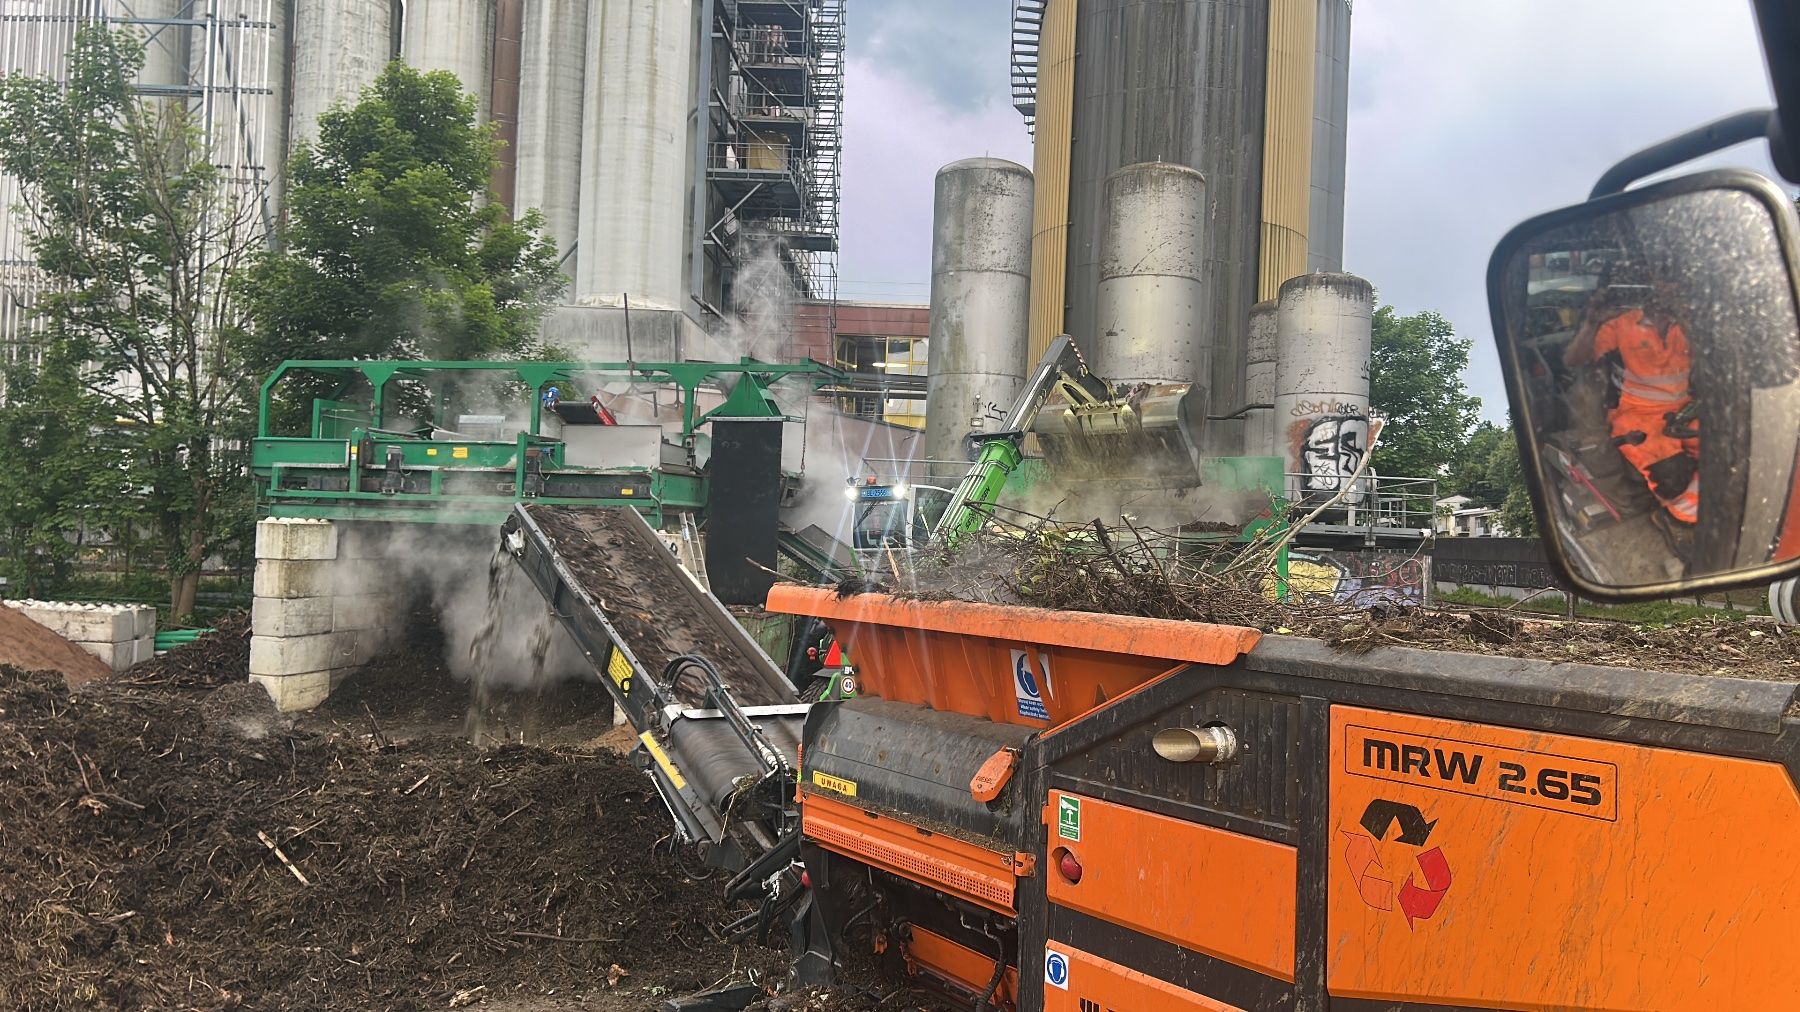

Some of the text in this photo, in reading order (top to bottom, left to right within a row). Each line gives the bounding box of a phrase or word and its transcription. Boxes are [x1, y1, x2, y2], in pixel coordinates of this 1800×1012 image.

[821, 777, 847, 792] UWAGA
[1363, 738, 1602, 806] MRW 2.65
